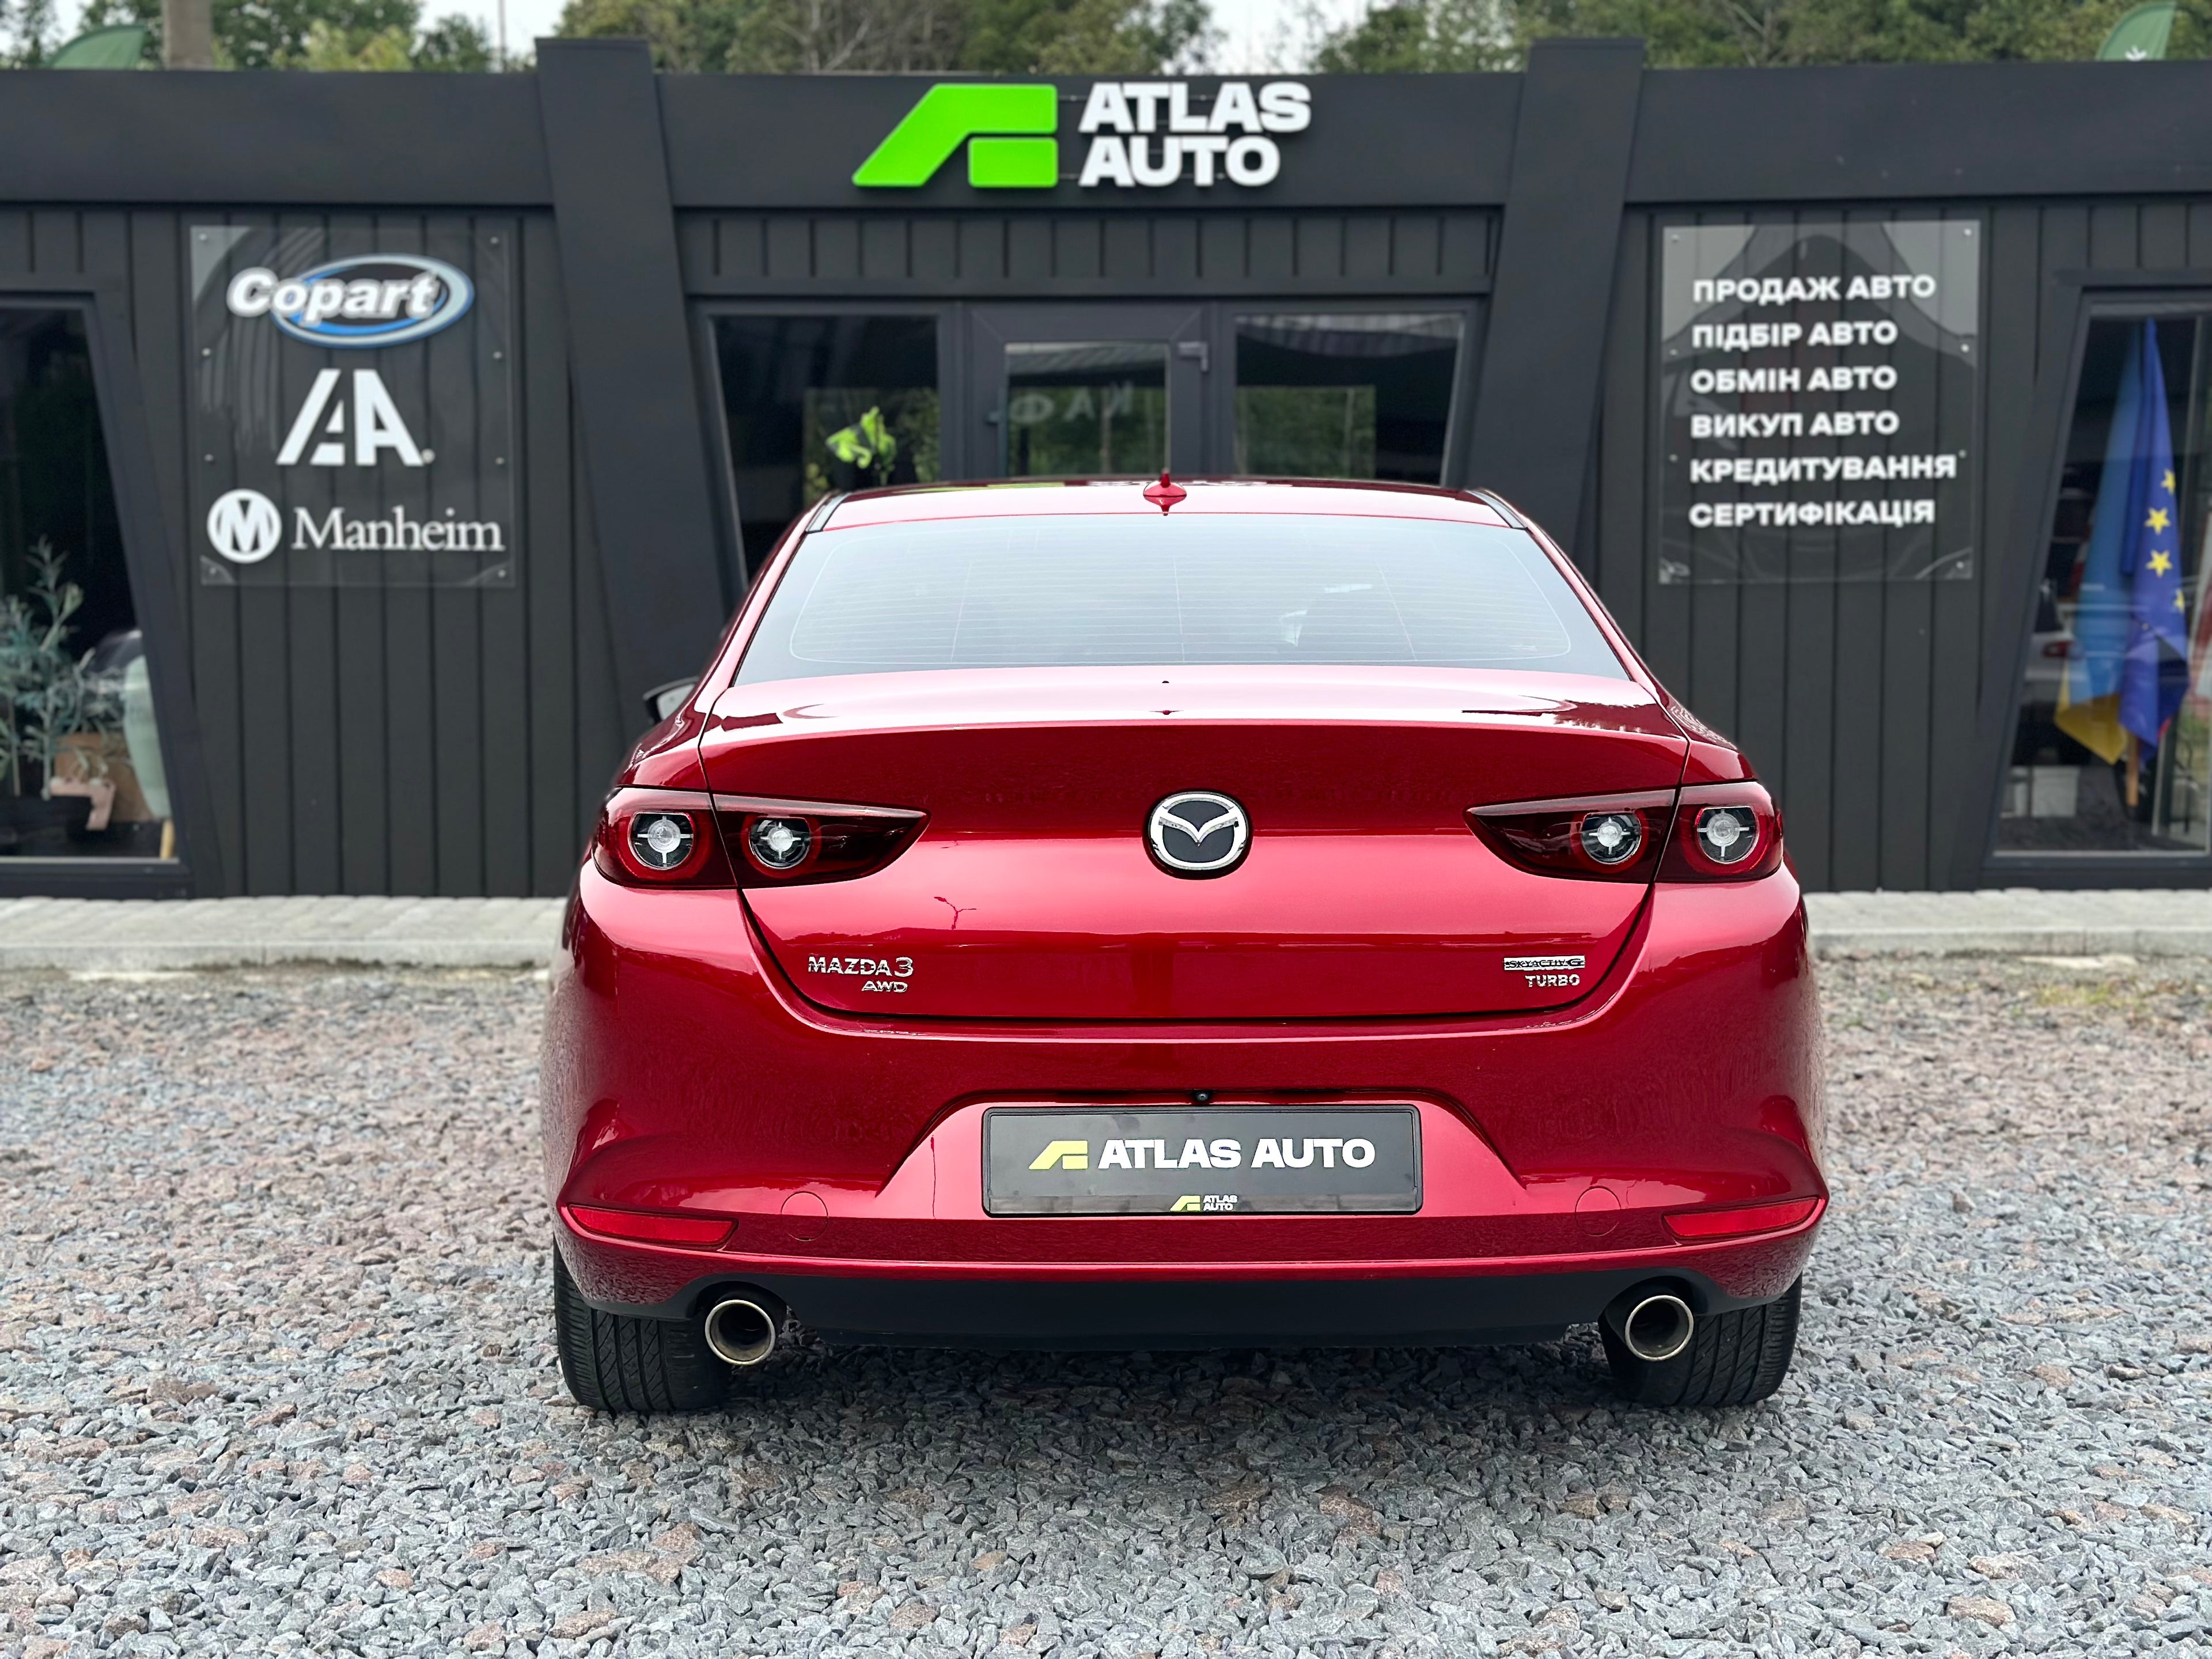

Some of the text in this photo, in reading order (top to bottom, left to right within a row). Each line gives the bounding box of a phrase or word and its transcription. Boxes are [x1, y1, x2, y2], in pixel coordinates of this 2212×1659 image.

[1079, 82, 1311, 133] ATLAS
[1079, 136, 1280, 186] AUTO
[228, 268, 440, 327] Copart
[1693, 274, 1936, 305] ПРОДАЖ АВТО
[1692, 320, 1898, 351] ПІДБІР АВТО
[1691, 365, 1897, 393] ОБМІН АВТО
[1691, 410, 1900, 438] ВИКУП АВТО
[1690, 454, 1956, 486] КРЕДИТУВАННЯ
[292, 505, 505, 551] Manheim
[1689, 499, 1936, 528] СЕРТИФІКАЦІЯ
[861, 980, 908, 993] AWD
[1525, 974, 1580, 987] TURBO
[1098, 1138, 1376, 1169] ATLAS AUTO
[1203, 1194, 1238, 1203] ATLAS
[1203, 1203, 1233, 1211] AUTO
